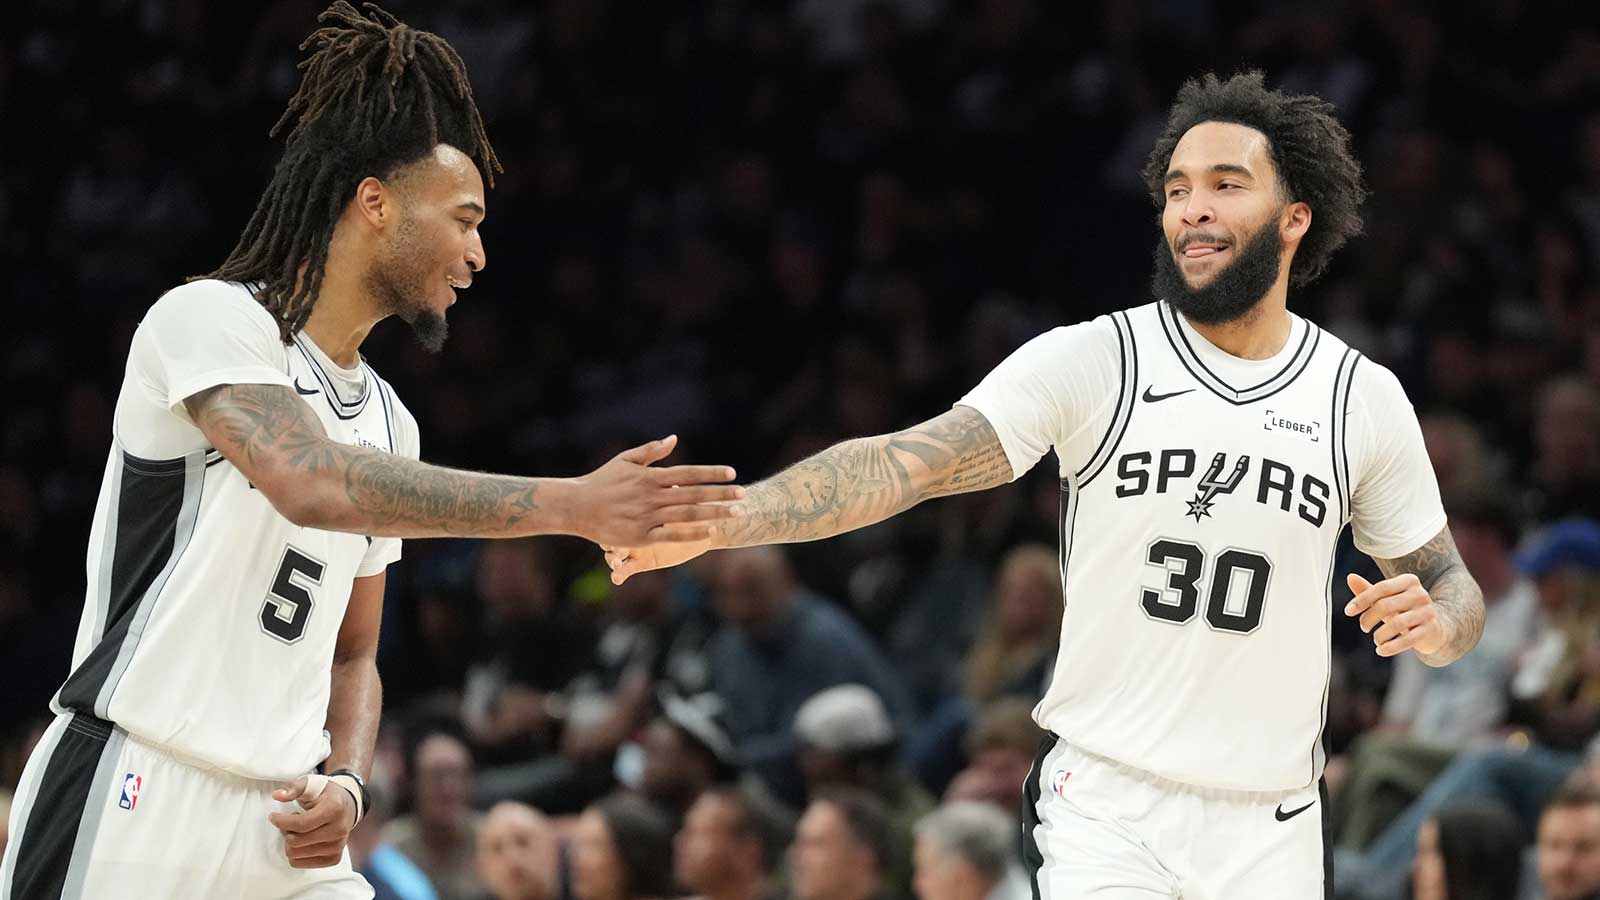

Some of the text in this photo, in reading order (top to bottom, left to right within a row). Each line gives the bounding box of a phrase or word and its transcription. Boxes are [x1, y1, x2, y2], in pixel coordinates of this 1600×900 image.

[1272, 416, 1313, 435] LEDGER
[1116, 449, 1330, 528] SPURS
[258, 543, 328, 647] 5
[1139, 536, 1275, 636] 30
